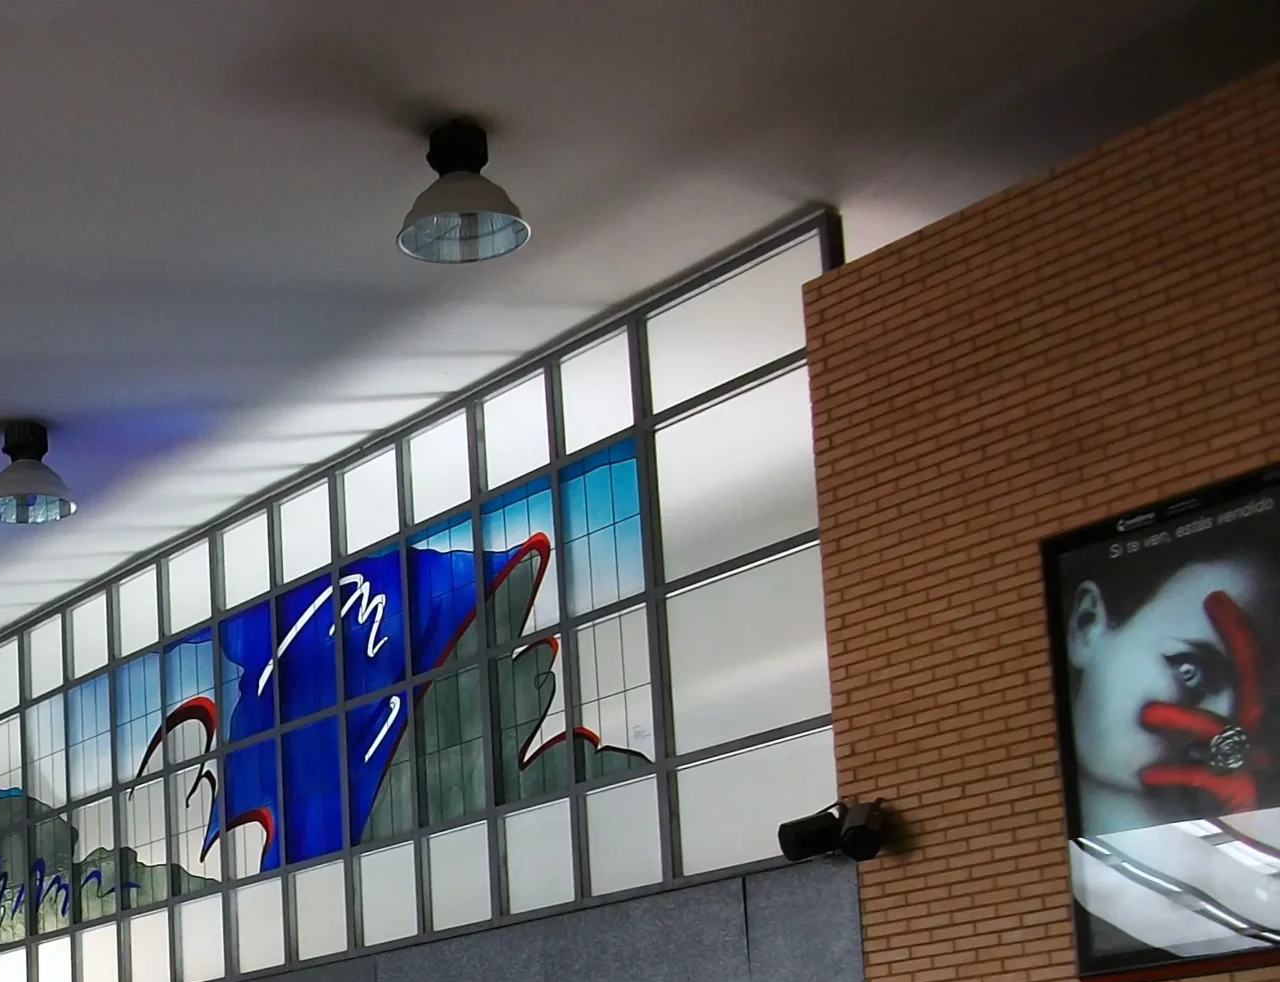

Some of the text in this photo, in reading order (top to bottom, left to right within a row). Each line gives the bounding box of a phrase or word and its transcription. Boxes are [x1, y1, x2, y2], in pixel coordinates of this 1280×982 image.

[1110, 542, 1123, 559] Si
[1126, 540, 1141, 553] te
[1217, 497, 1275, 525] vendido
